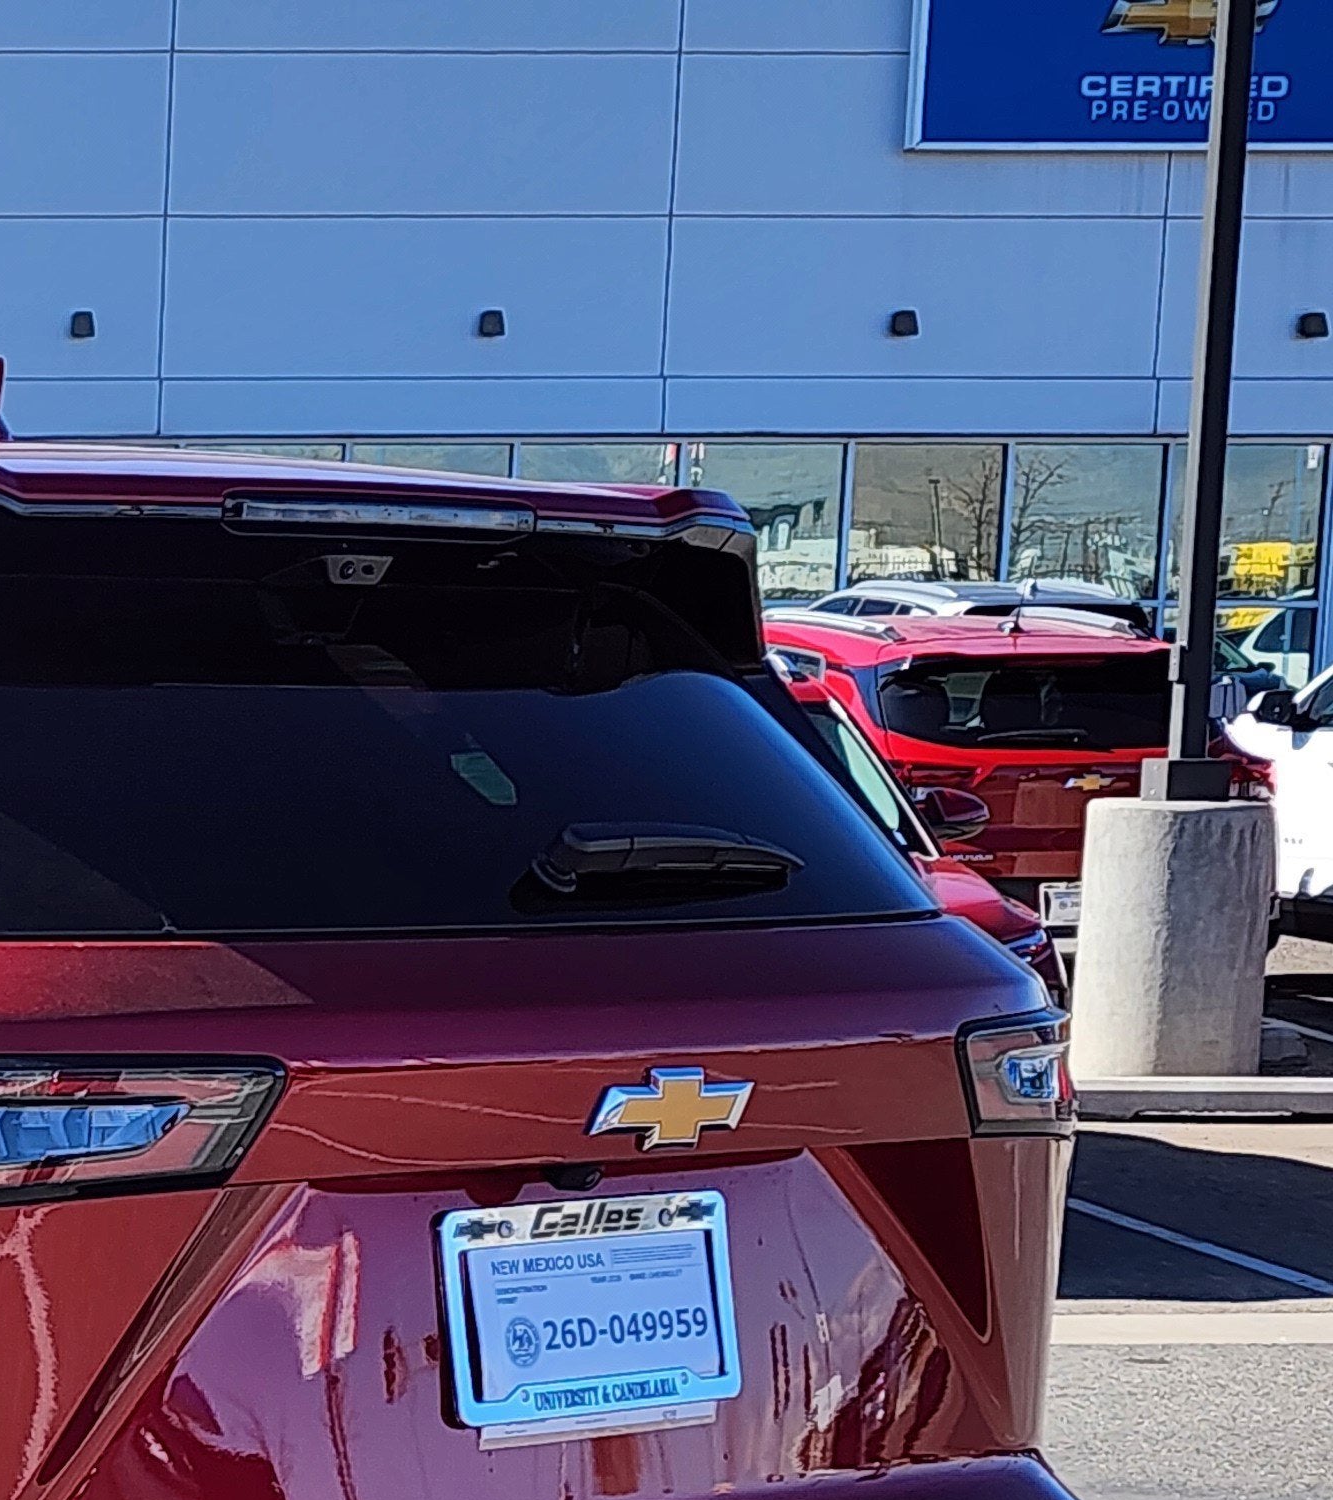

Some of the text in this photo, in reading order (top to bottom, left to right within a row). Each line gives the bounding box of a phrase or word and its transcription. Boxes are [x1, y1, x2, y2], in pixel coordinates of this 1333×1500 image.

[1081, 75, 1289, 97] CERTIFD
[1091, 100, 1275, 121] PRE-OWD
[491, 1259, 520, 1276] NEW
[523, 1255, 574, 1273] MEXICO
[577, 1252, 606, 1269] USA
[542, 1306, 709, 1351] 26D-049959
[534, 1377, 681, 1411] UNIVERSITY & CANDELARIA
